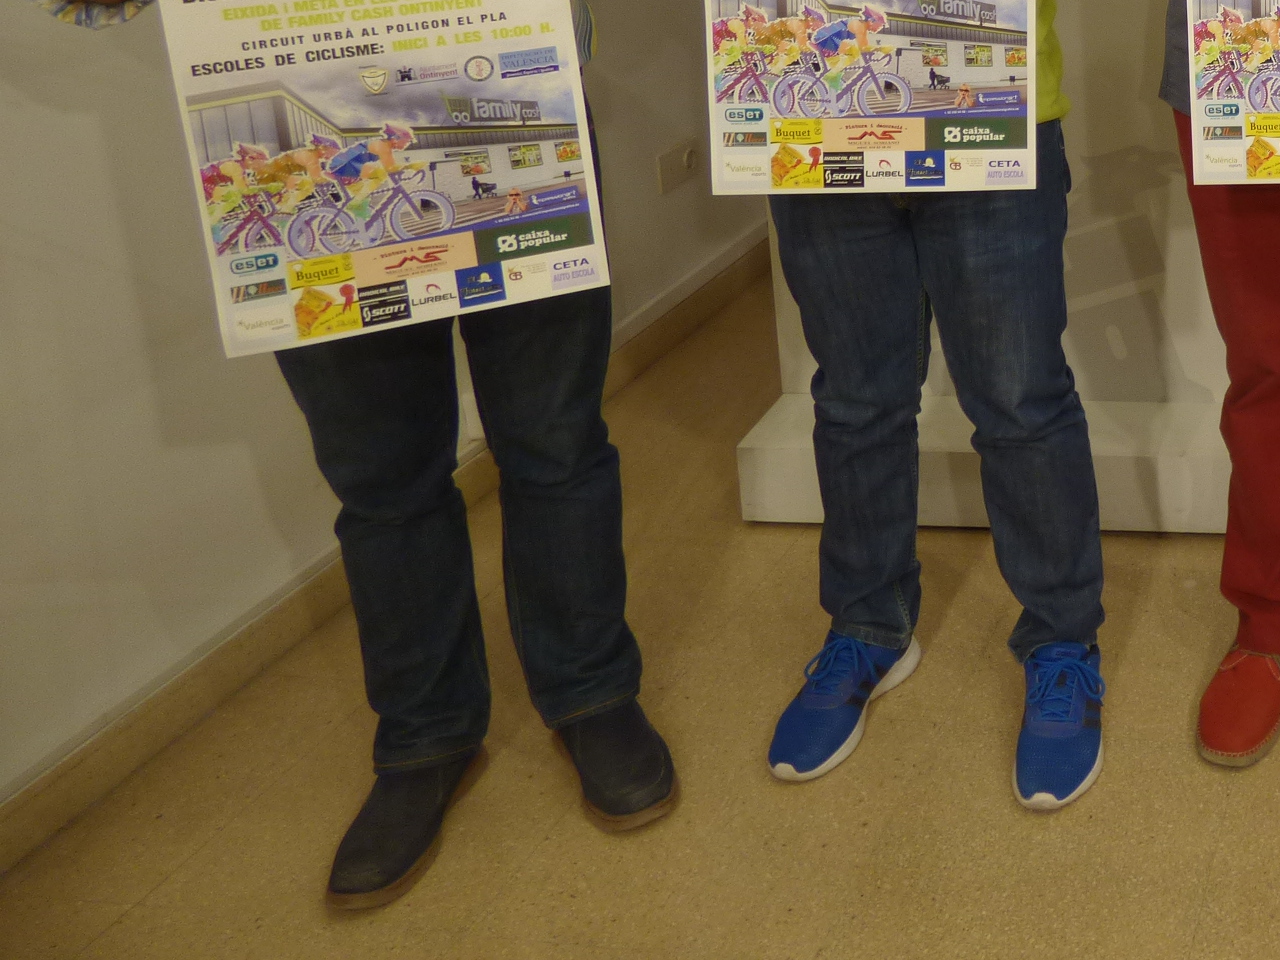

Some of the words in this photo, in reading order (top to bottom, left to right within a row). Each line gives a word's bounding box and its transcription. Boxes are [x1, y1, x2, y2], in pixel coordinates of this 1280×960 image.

[241, 35, 304, 51] CIRCUIT
[313, 27, 354, 43] URBÀ
[361, 27, 379, 37] AL
[386, 18, 450, 34] POLIGON
[457, 16, 474, 26] EL
[480, 12, 507, 23] PLA
[962, 126, 990, 134] caixa
[963, 132, 1005, 143] popular
